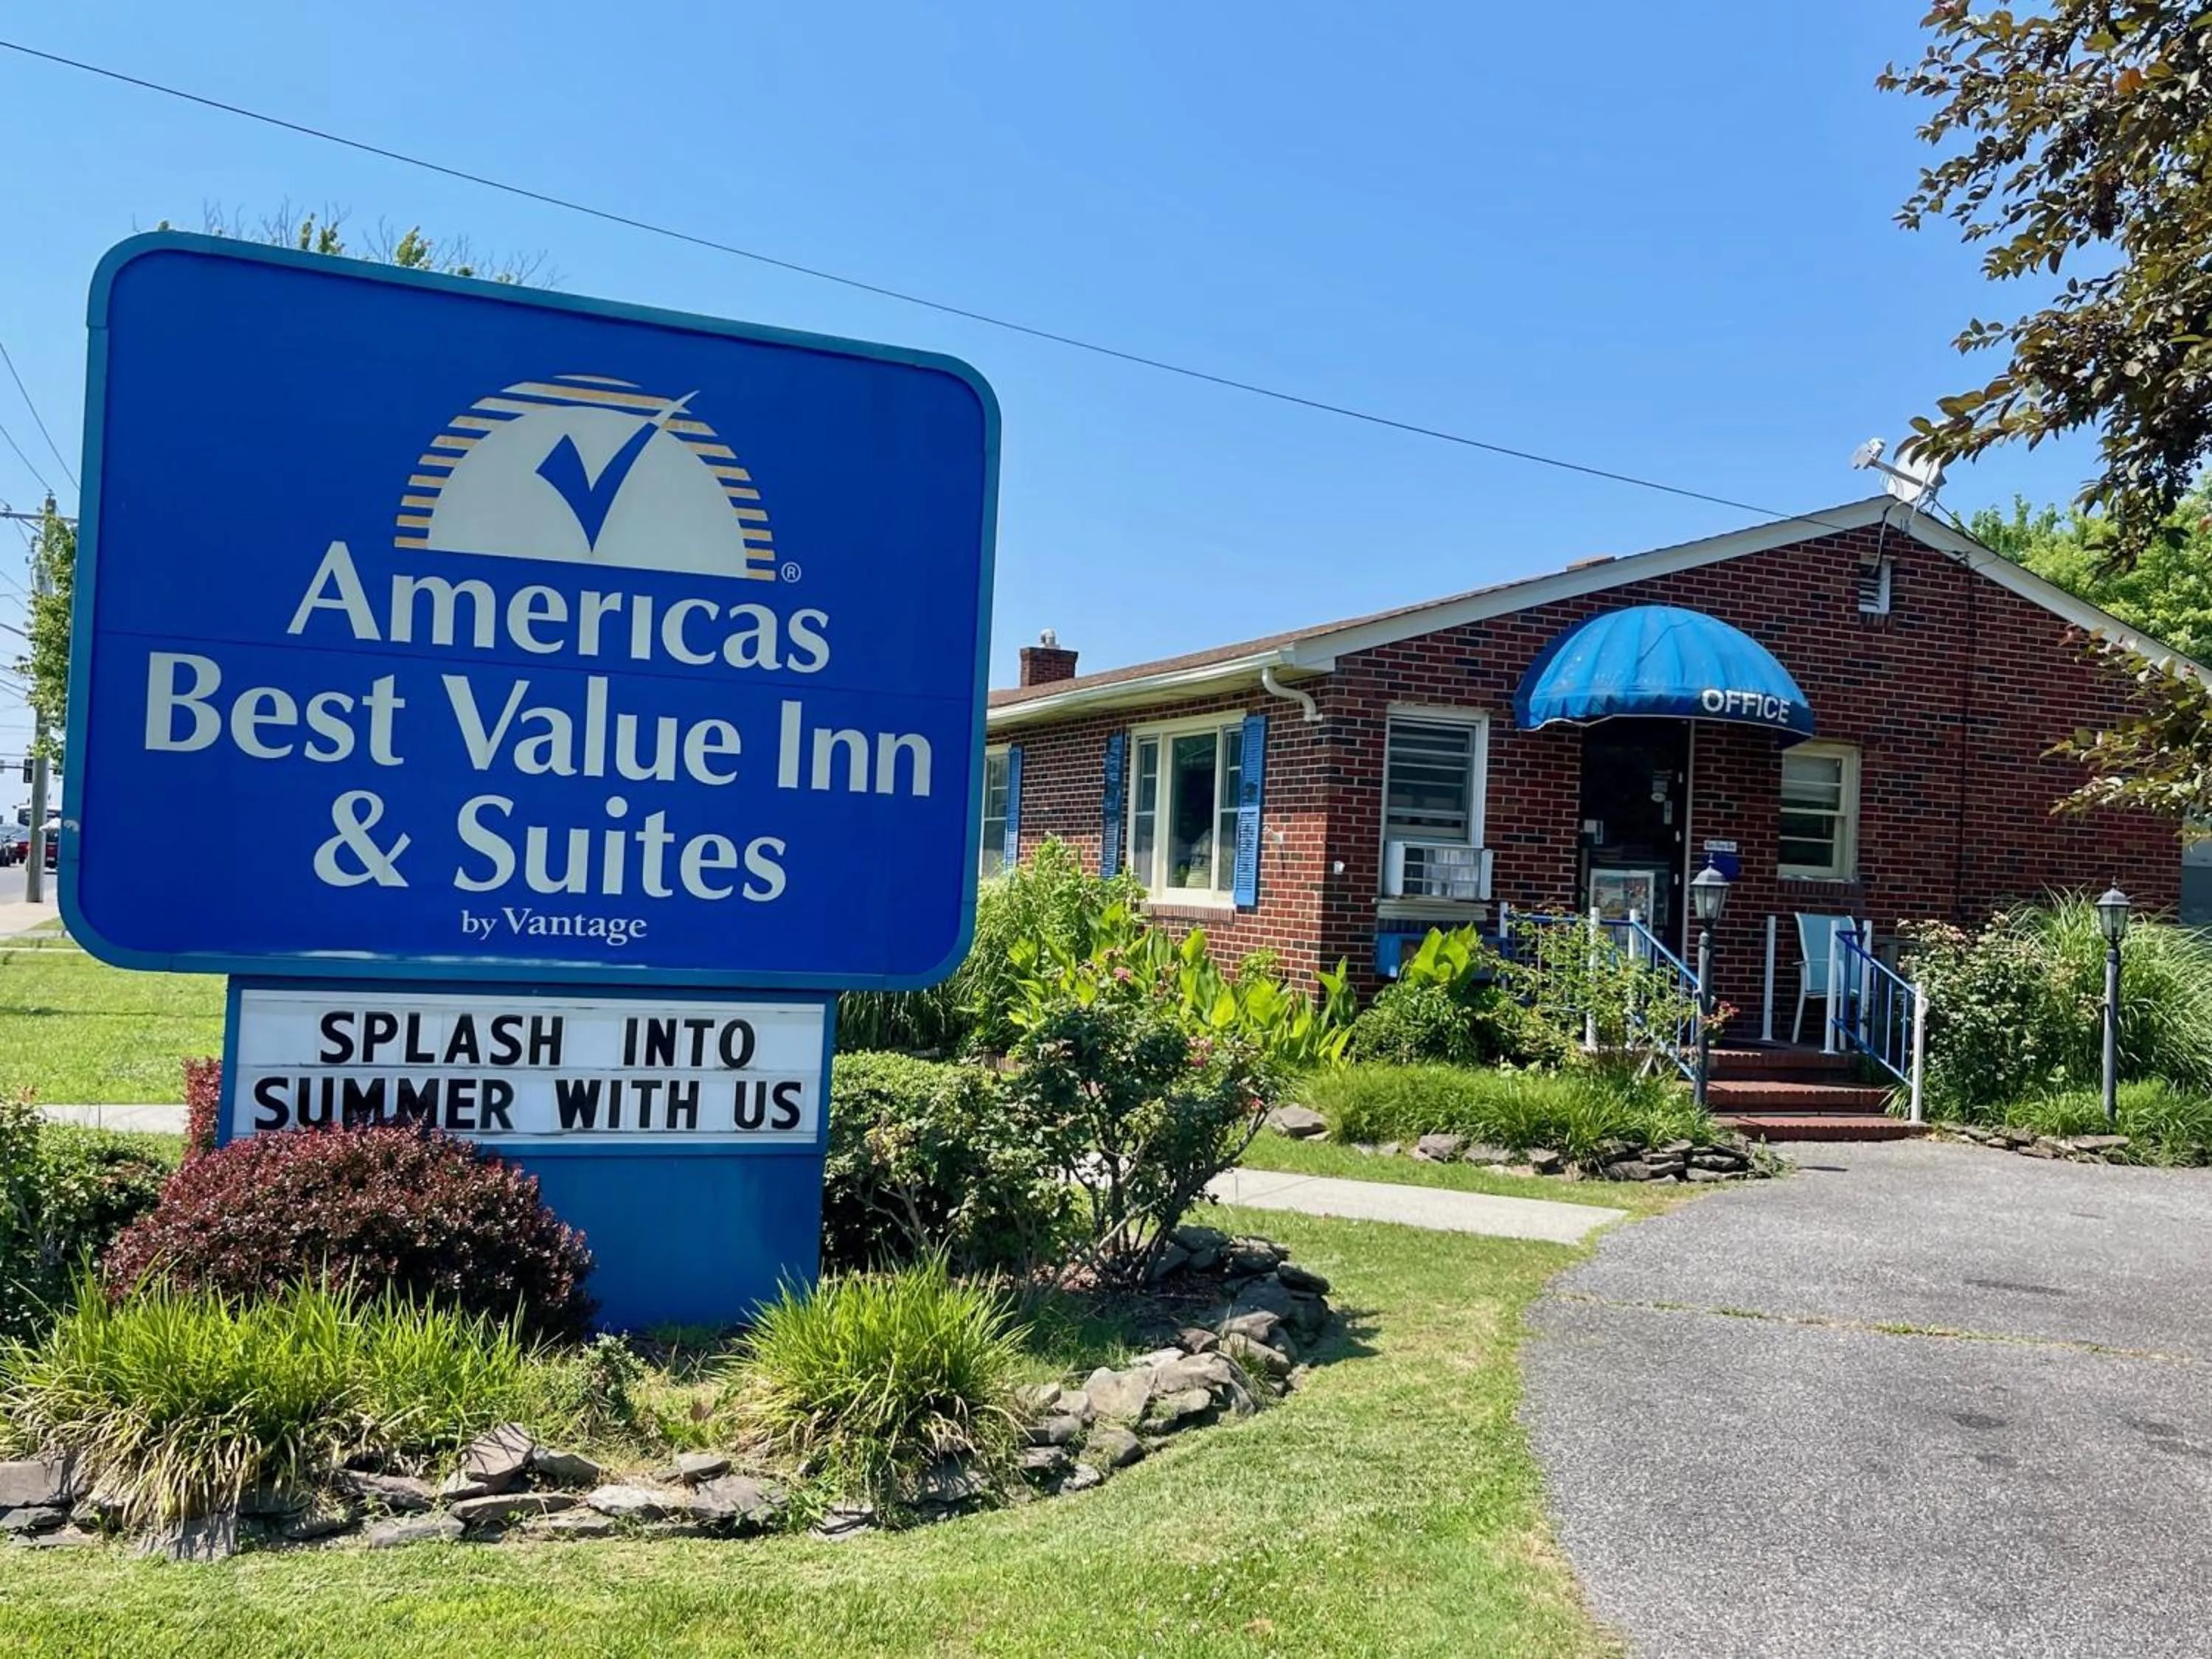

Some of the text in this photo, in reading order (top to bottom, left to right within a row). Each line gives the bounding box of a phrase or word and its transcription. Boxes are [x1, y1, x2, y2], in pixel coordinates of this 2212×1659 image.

[288, 541, 830, 672] Americas
[145, 652, 932, 796] Best Value Inn
[1702, 689, 1790, 723] OFFICE
[314, 790, 787, 901] & Suites
[461, 907, 647, 946] by Vantage
[320, 1011, 756, 1069] SPLASH INTO
[254, 1077, 802, 1131] SUMMER WITH US
